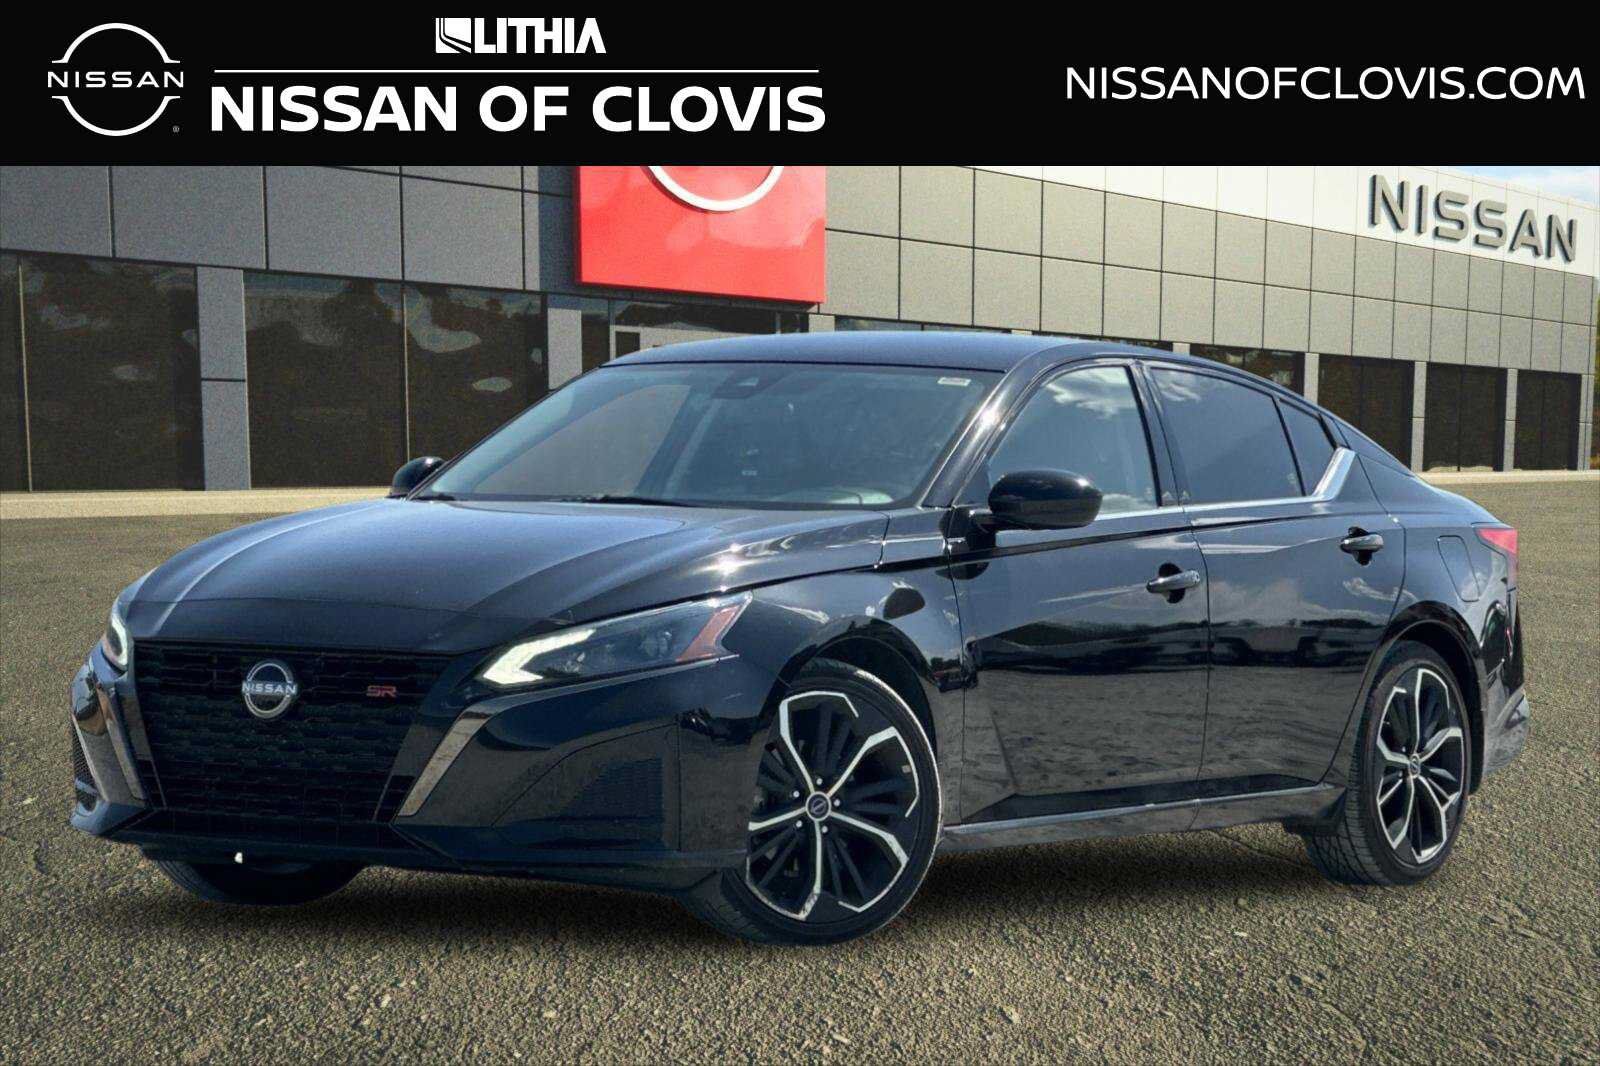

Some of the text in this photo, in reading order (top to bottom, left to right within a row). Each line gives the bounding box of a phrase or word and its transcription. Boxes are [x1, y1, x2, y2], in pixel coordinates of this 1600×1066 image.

[1369, 174, 1577, 262] NISSAN
[242, 682, 297, 695] NISSAN
[366, 685, 397, 698] SR
